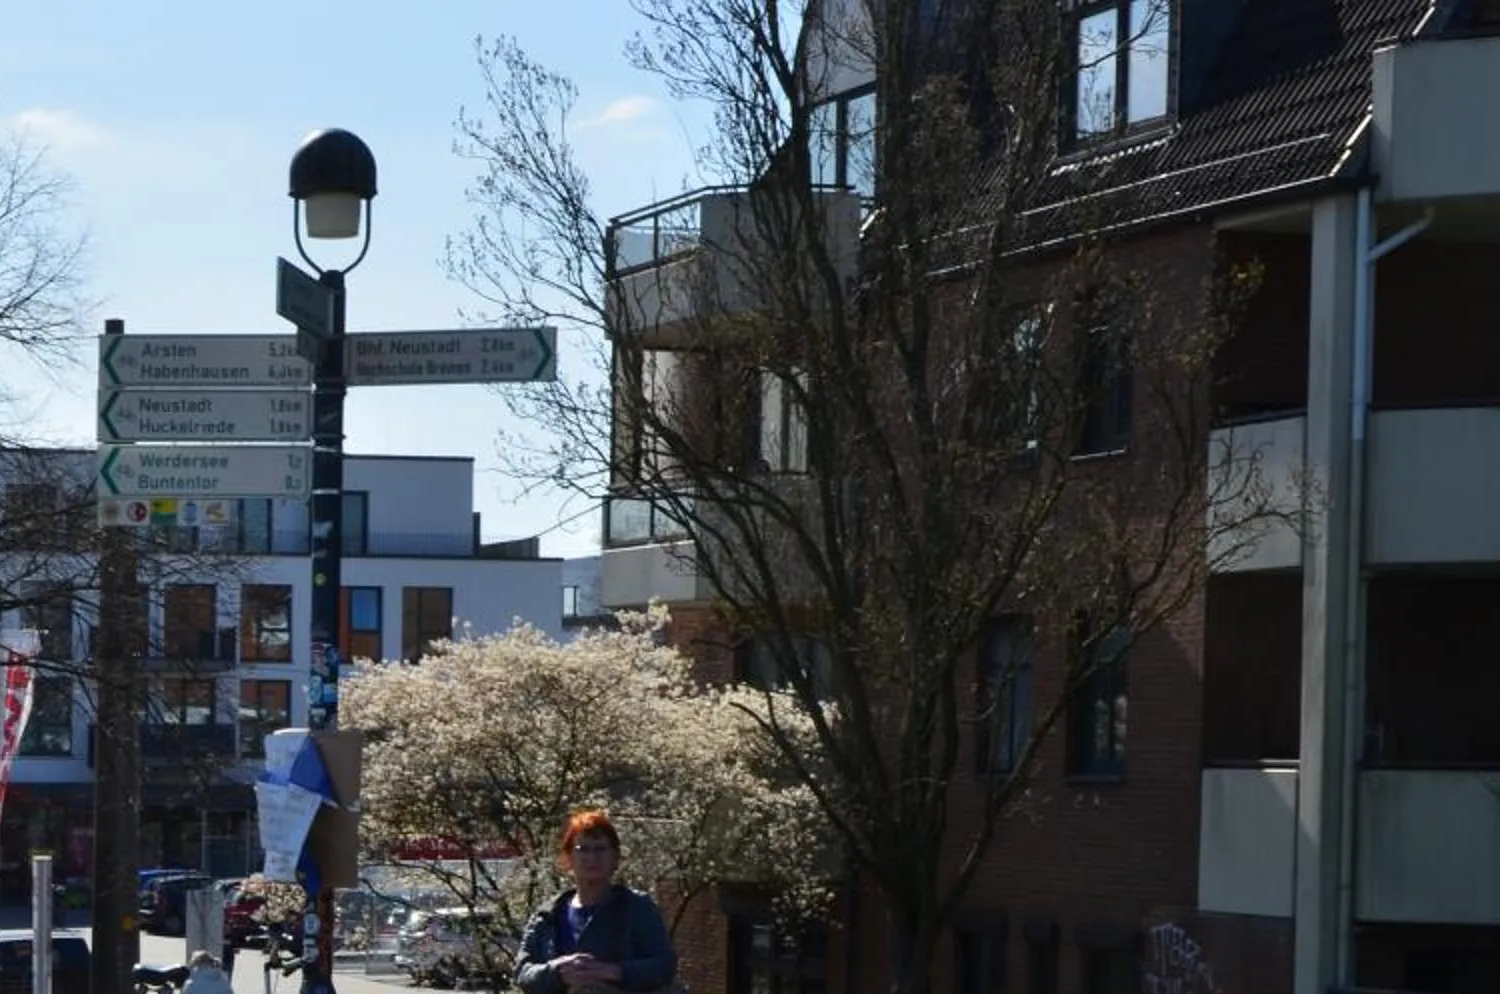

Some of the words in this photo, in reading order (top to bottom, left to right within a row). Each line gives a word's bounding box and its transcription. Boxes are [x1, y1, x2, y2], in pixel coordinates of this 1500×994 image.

[142, 342, 197, 358] Arsten
[389, 338, 461, 354] Neustadt
[140, 364, 250, 379] Habenhausen
[138, 399, 213, 413] Neustadt
[138, 420, 237, 434] Huckelriede
[138, 453, 230, 468] Werdersee
[137, 475, 221, 490] Buntentor
